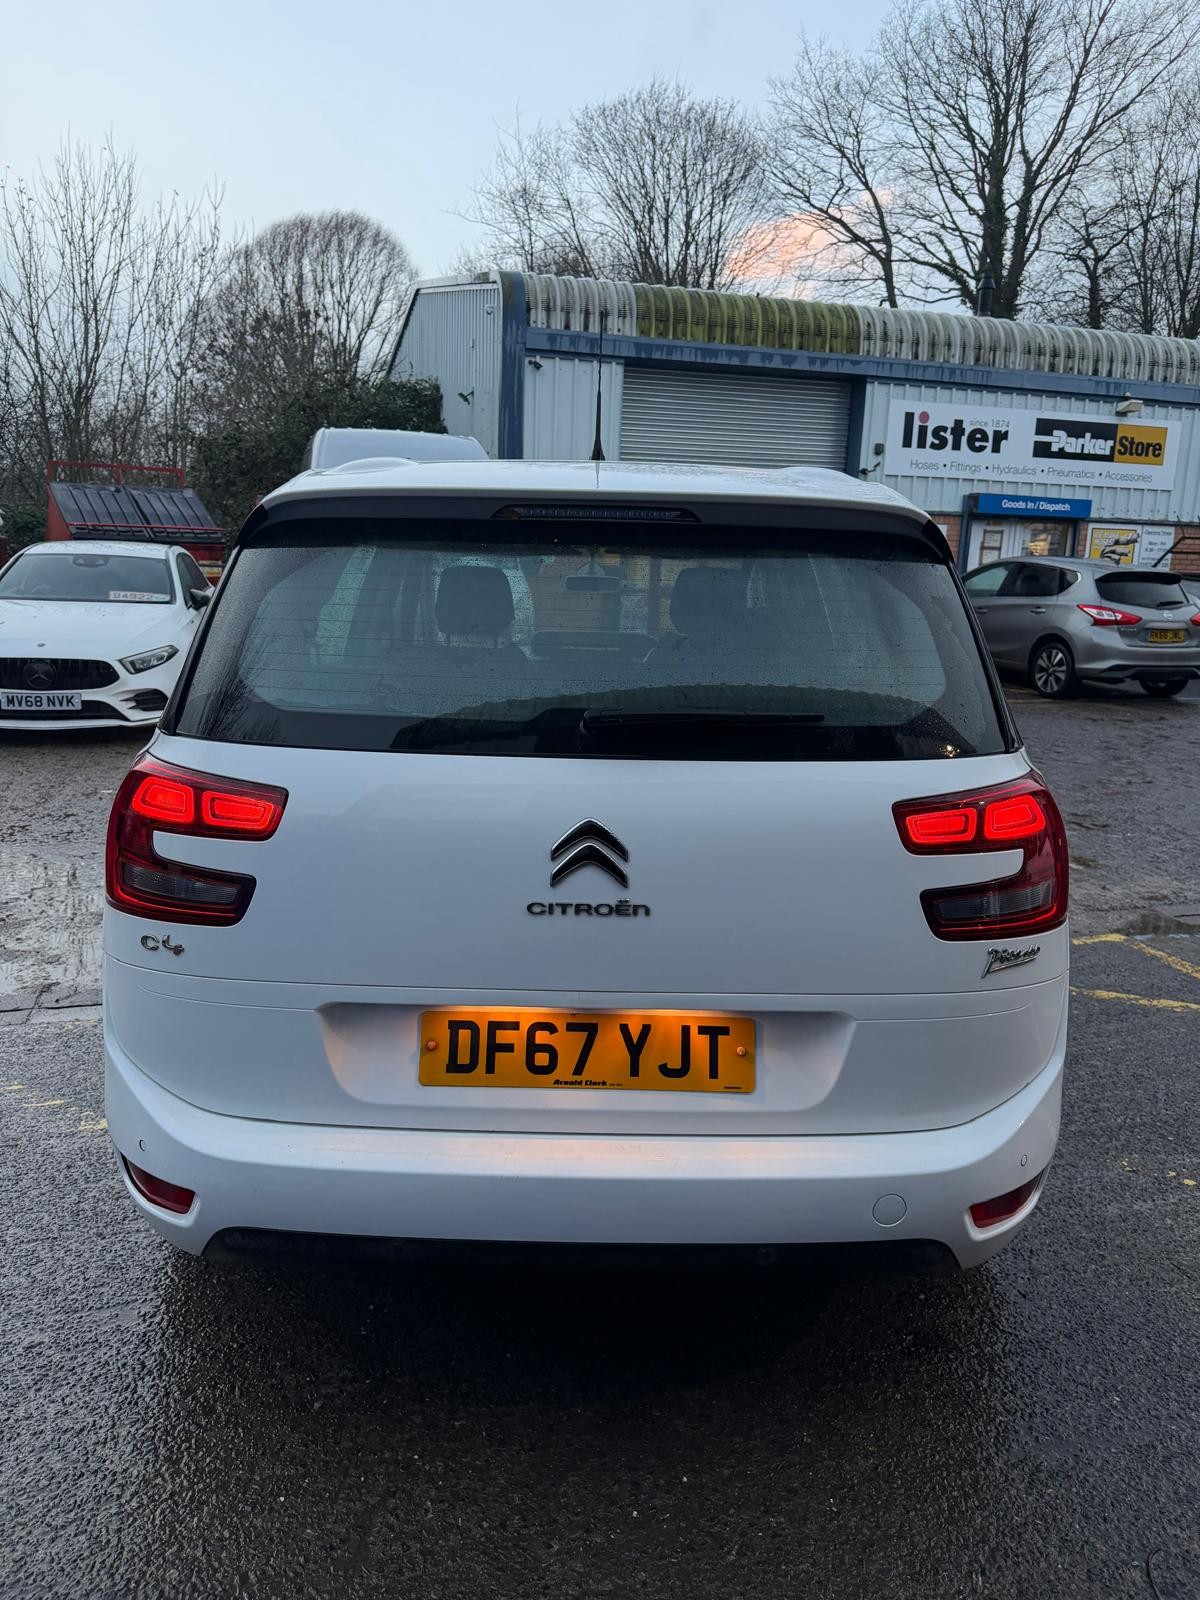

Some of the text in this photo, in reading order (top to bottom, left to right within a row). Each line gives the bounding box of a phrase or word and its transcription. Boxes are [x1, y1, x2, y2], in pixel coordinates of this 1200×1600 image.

[901, 410, 1009, 454] lister
[969, 417, 1010, 429] since 1874
[1050, 429, 1163, 458] Parker Store
[910, 459, 1153, 483] Hoses Fittings Hydraulics Pneumatics Accessories
[1001, 499, 1026, 509] Goods
[1027, 500, 1034, 509] In
[1039, 501, 1071, 513] Dispatch
[6, 695, 76, 708] MV68 NVK
[140, 933, 185, 956] C4
[445, 1019, 731, 1080] DF67 YJT
[553, 1078, 583, 1086] Arnold
[584, 1079, 608, 1087] Clark
